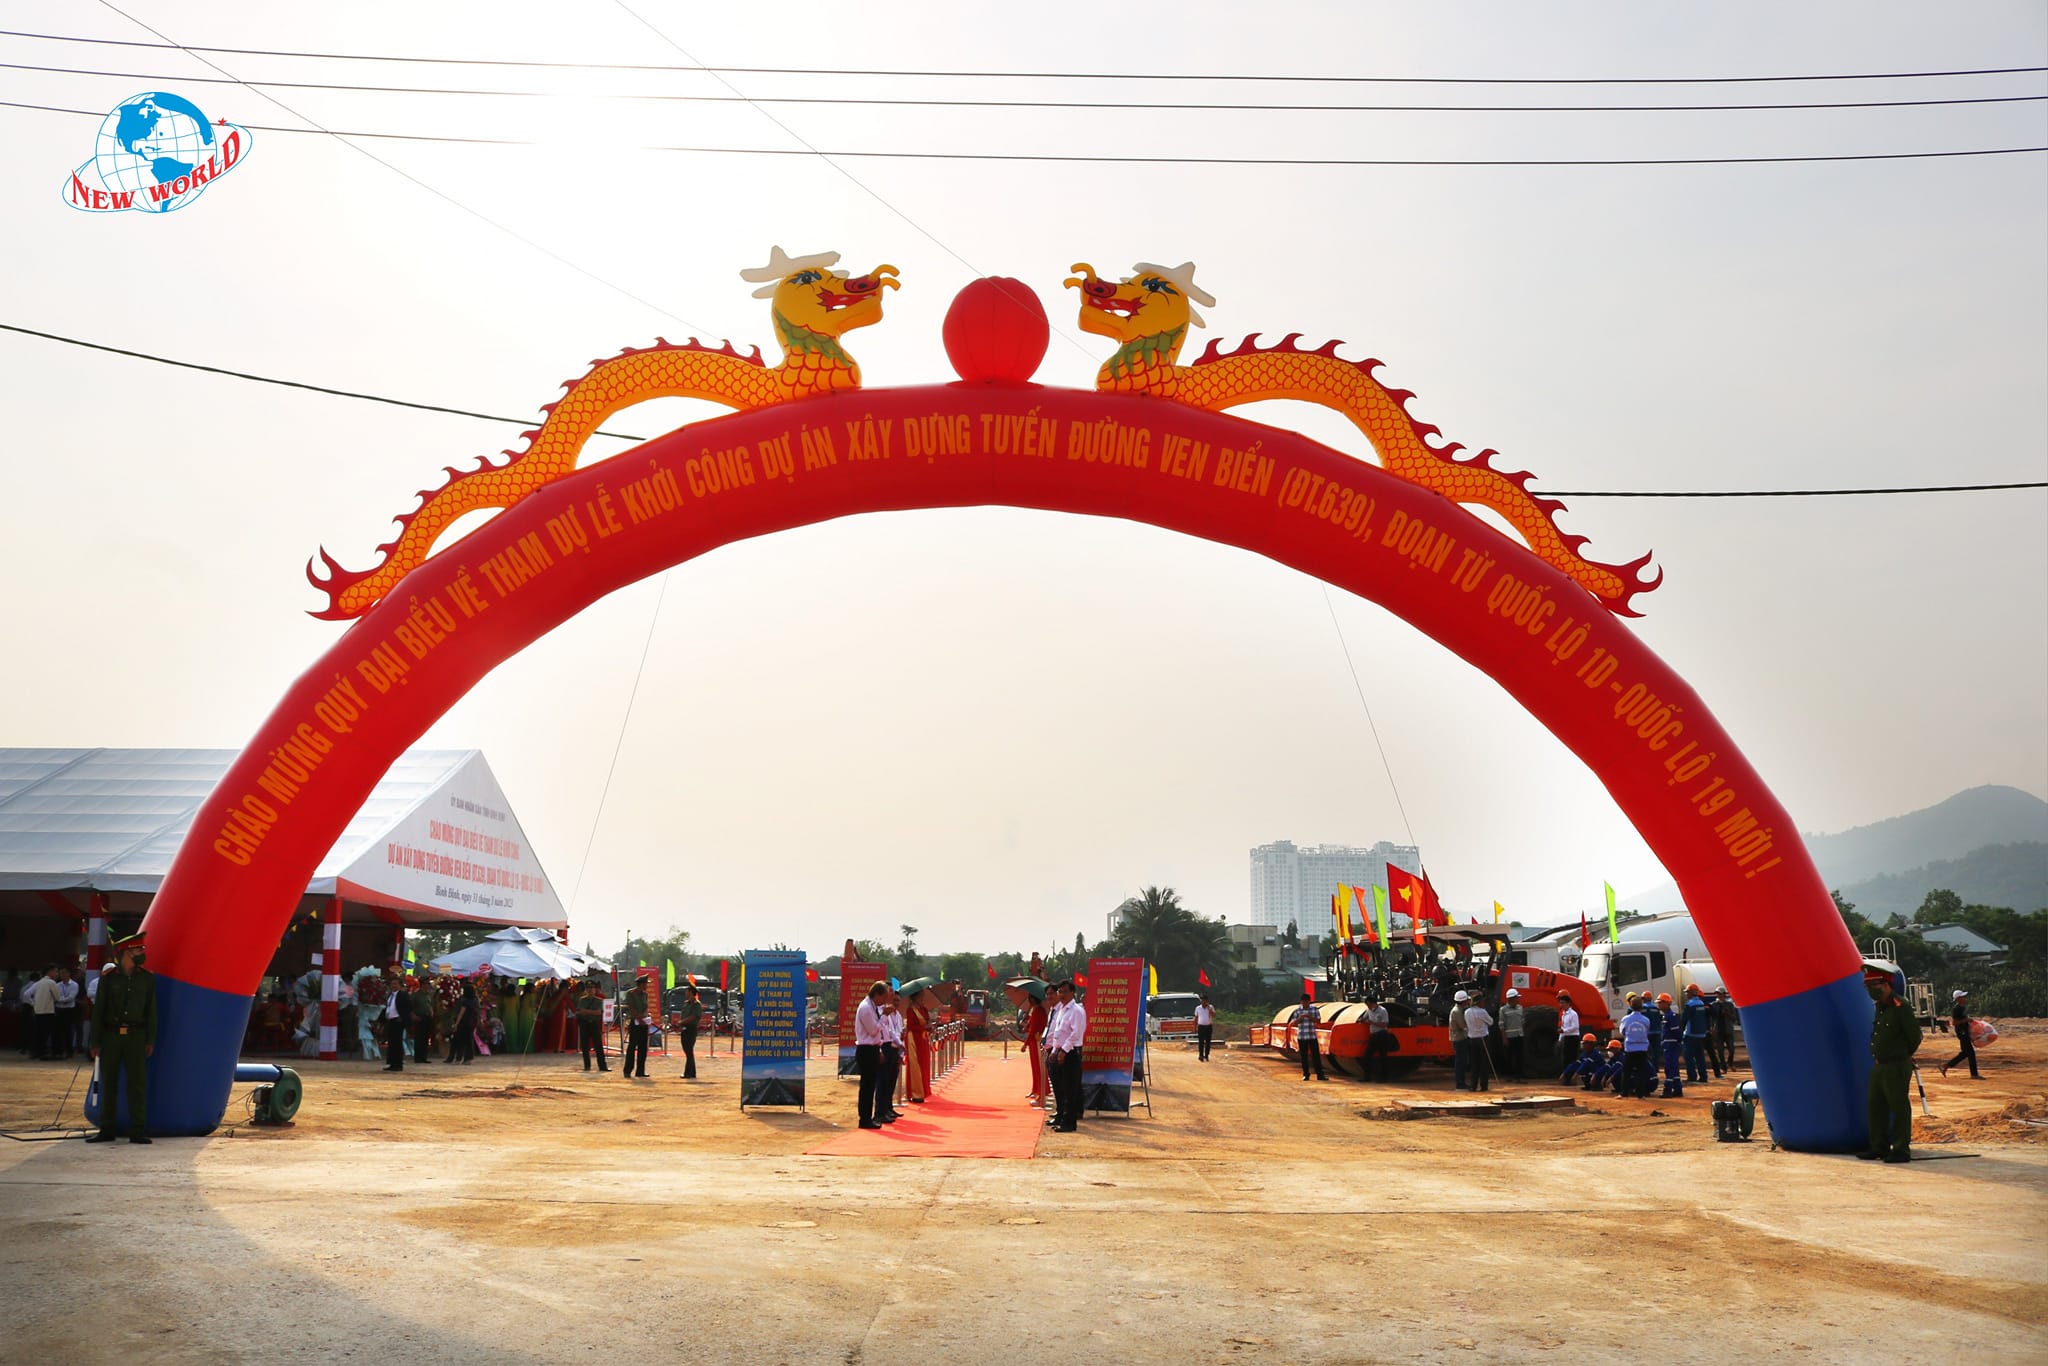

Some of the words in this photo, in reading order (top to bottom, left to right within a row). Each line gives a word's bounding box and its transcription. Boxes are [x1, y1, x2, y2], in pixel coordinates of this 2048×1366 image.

[213, 794, 279, 866] CHÀO
[256, 722, 334, 812] MỪNG
[314, 672, 369, 734] QUÝ
[356, 641, 411, 694] ĐẠI
[394, 595, 457, 660] BIỂU
[445, 564, 489, 618] VỀ
[479, 531, 554, 598] THAM
[545, 504, 591, 555] DỰ
[586, 482, 624, 539] LỄ
[620, 460, 685, 524] KHỞI
[685, 446, 756, 498] CÔNG
[758, 431, 796, 483] DỰ
[800, 424, 838, 471] ÁN
[847, 412, 893, 462] XÂY
[903, 412, 972, 464] DỰNG
[980, 406, 1057, 459] TUYẾN
[1067, 415, 1152, 468] ĐƯỜNG
[1159, 433, 1211, 481] VEN
[1213, 440, 1276, 497] BIỂN
[1381, 510, 1456, 573] ĐOẠN
[1451, 548, 1496, 593] TỪ
[1487, 573, 1557, 635] QUỐC
[1545, 617, 1592, 666] LỘ
[1663, 740, 1717, 785] LỘ
[1690, 776, 1736, 817] 19
